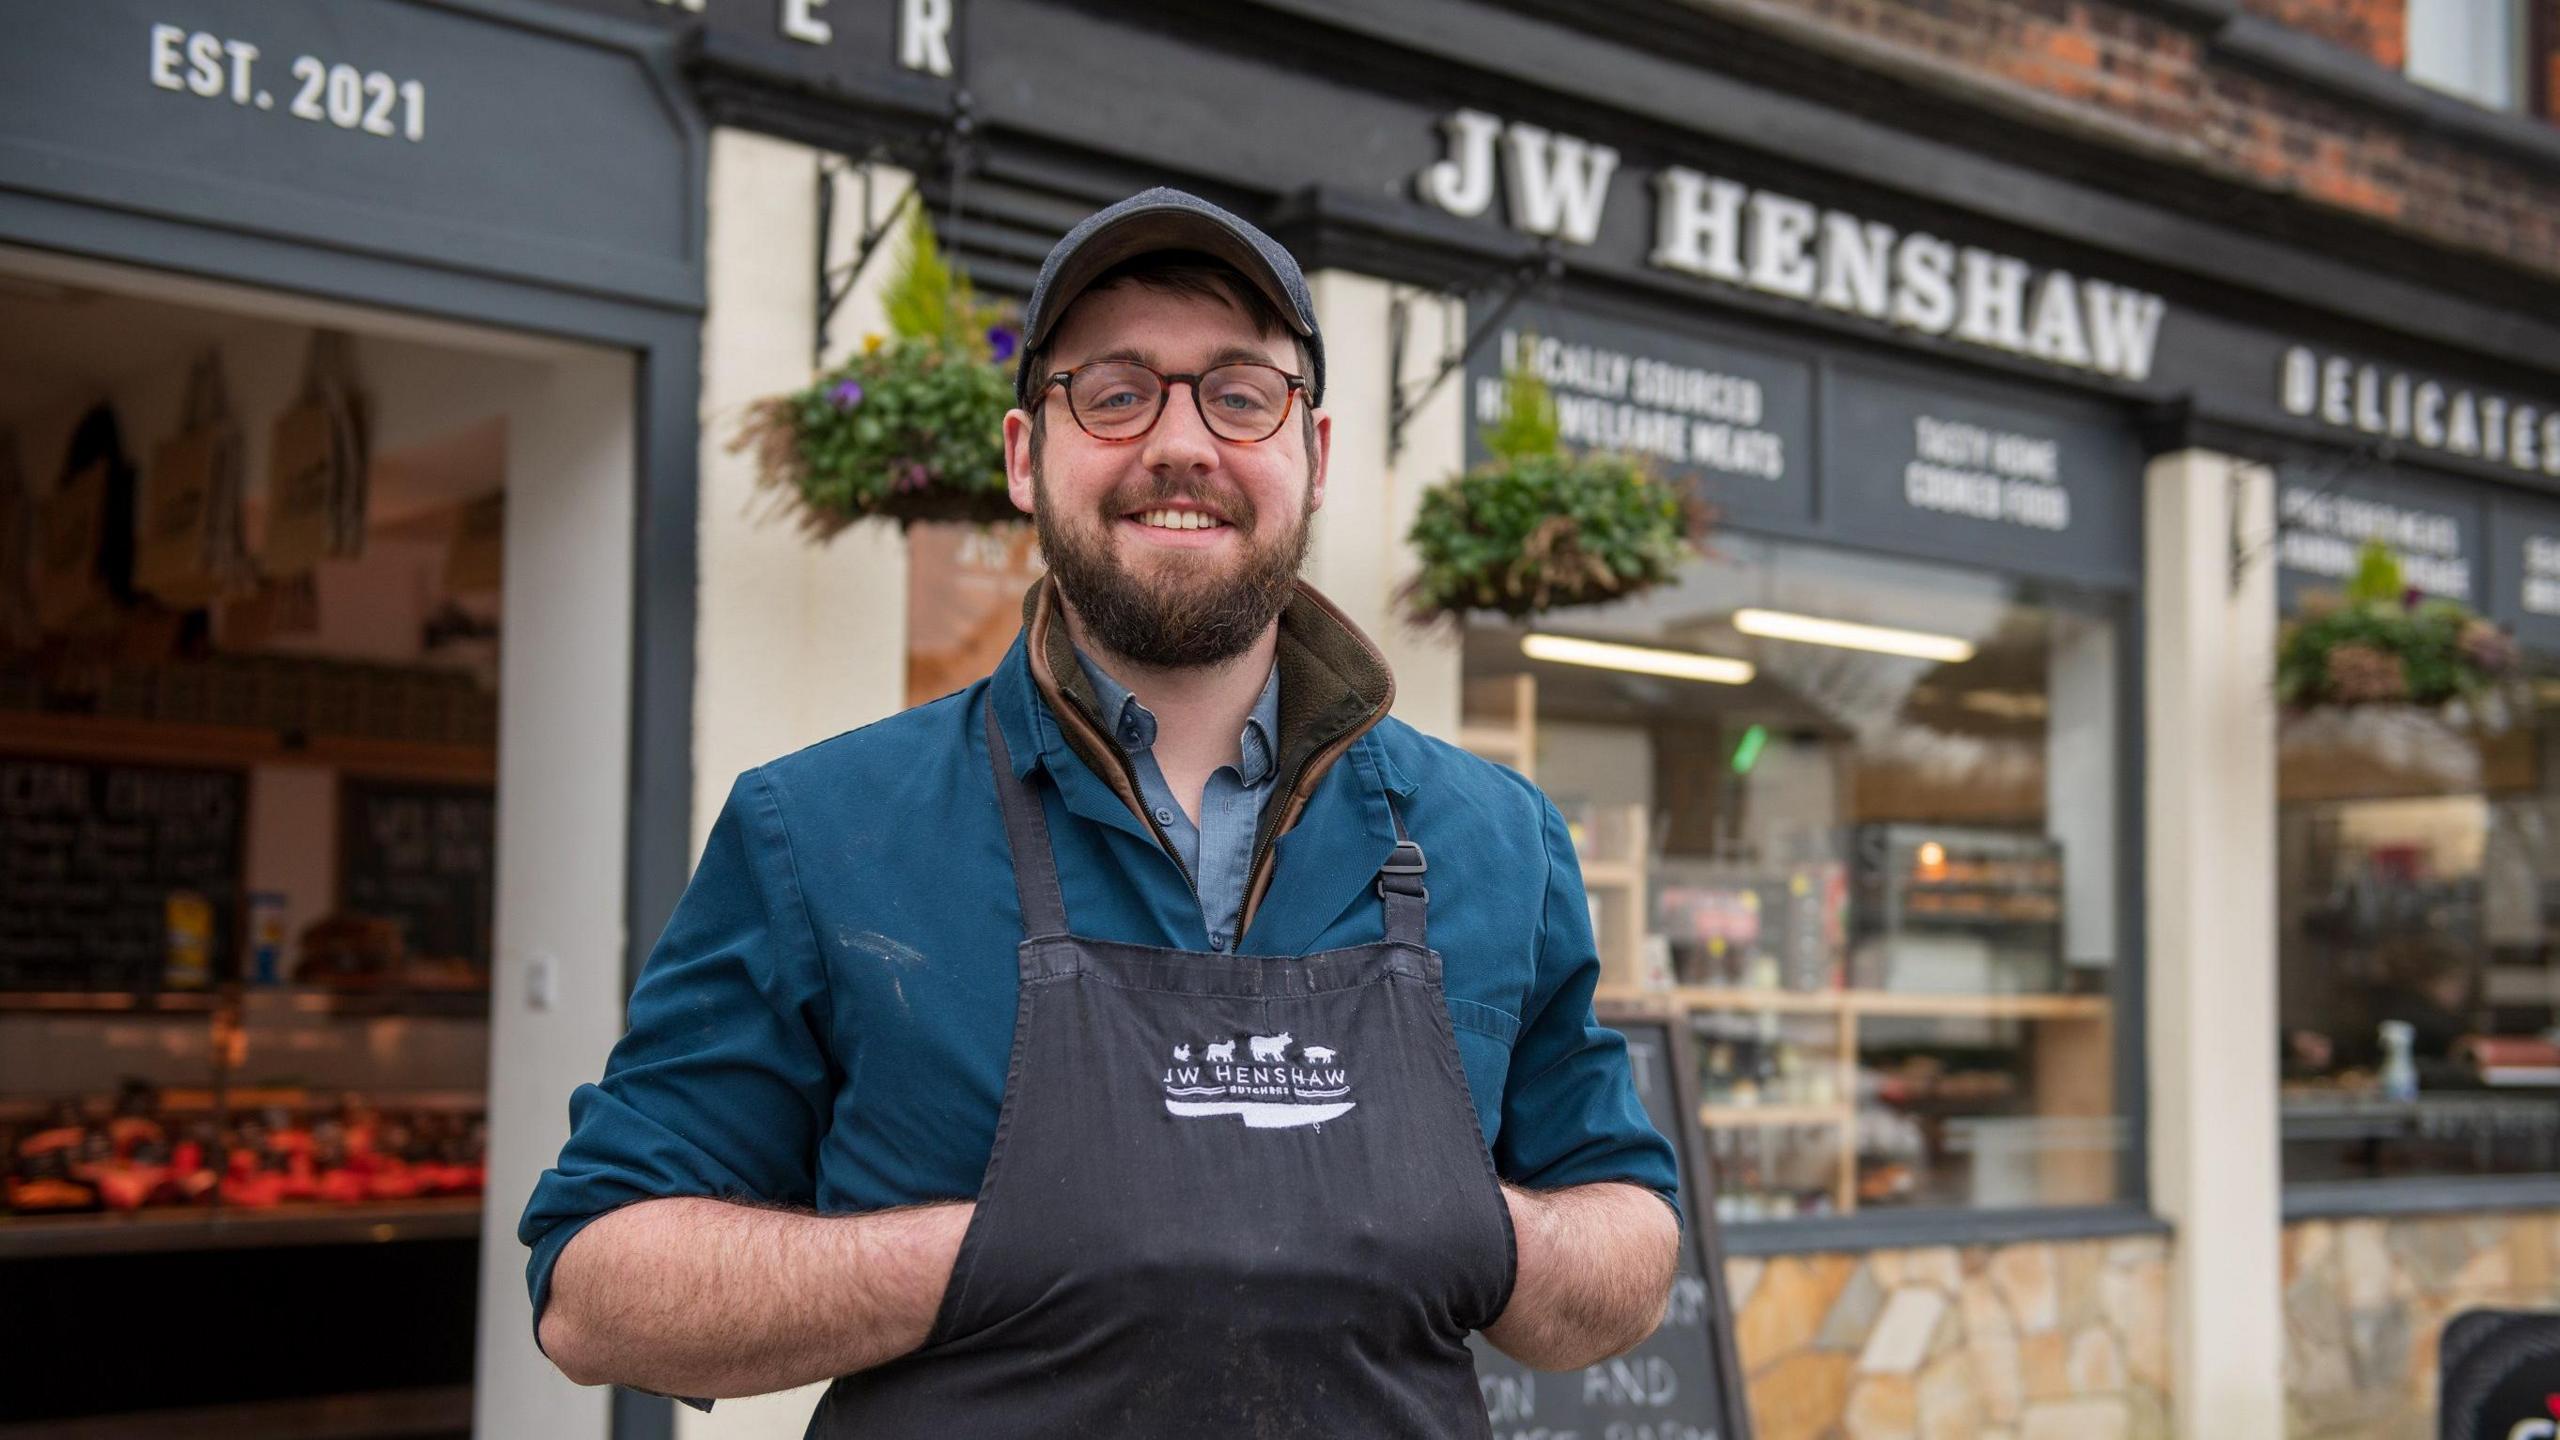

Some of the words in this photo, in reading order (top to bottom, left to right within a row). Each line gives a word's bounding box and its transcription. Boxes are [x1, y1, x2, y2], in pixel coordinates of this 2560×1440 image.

[151, 21, 275, 111] EST.
[289, 54, 425, 143] 2021
[1415, 106, 1621, 246] JW
[1650, 163, 2167, 382] HENSHAW
[1630, 356, 1764, 428] SOURCED
[1690, 419, 1785, 482] MEATS
[1215, 1064, 1346, 1087] HENSHAW
[1581, 1355, 1680, 1408] AND
